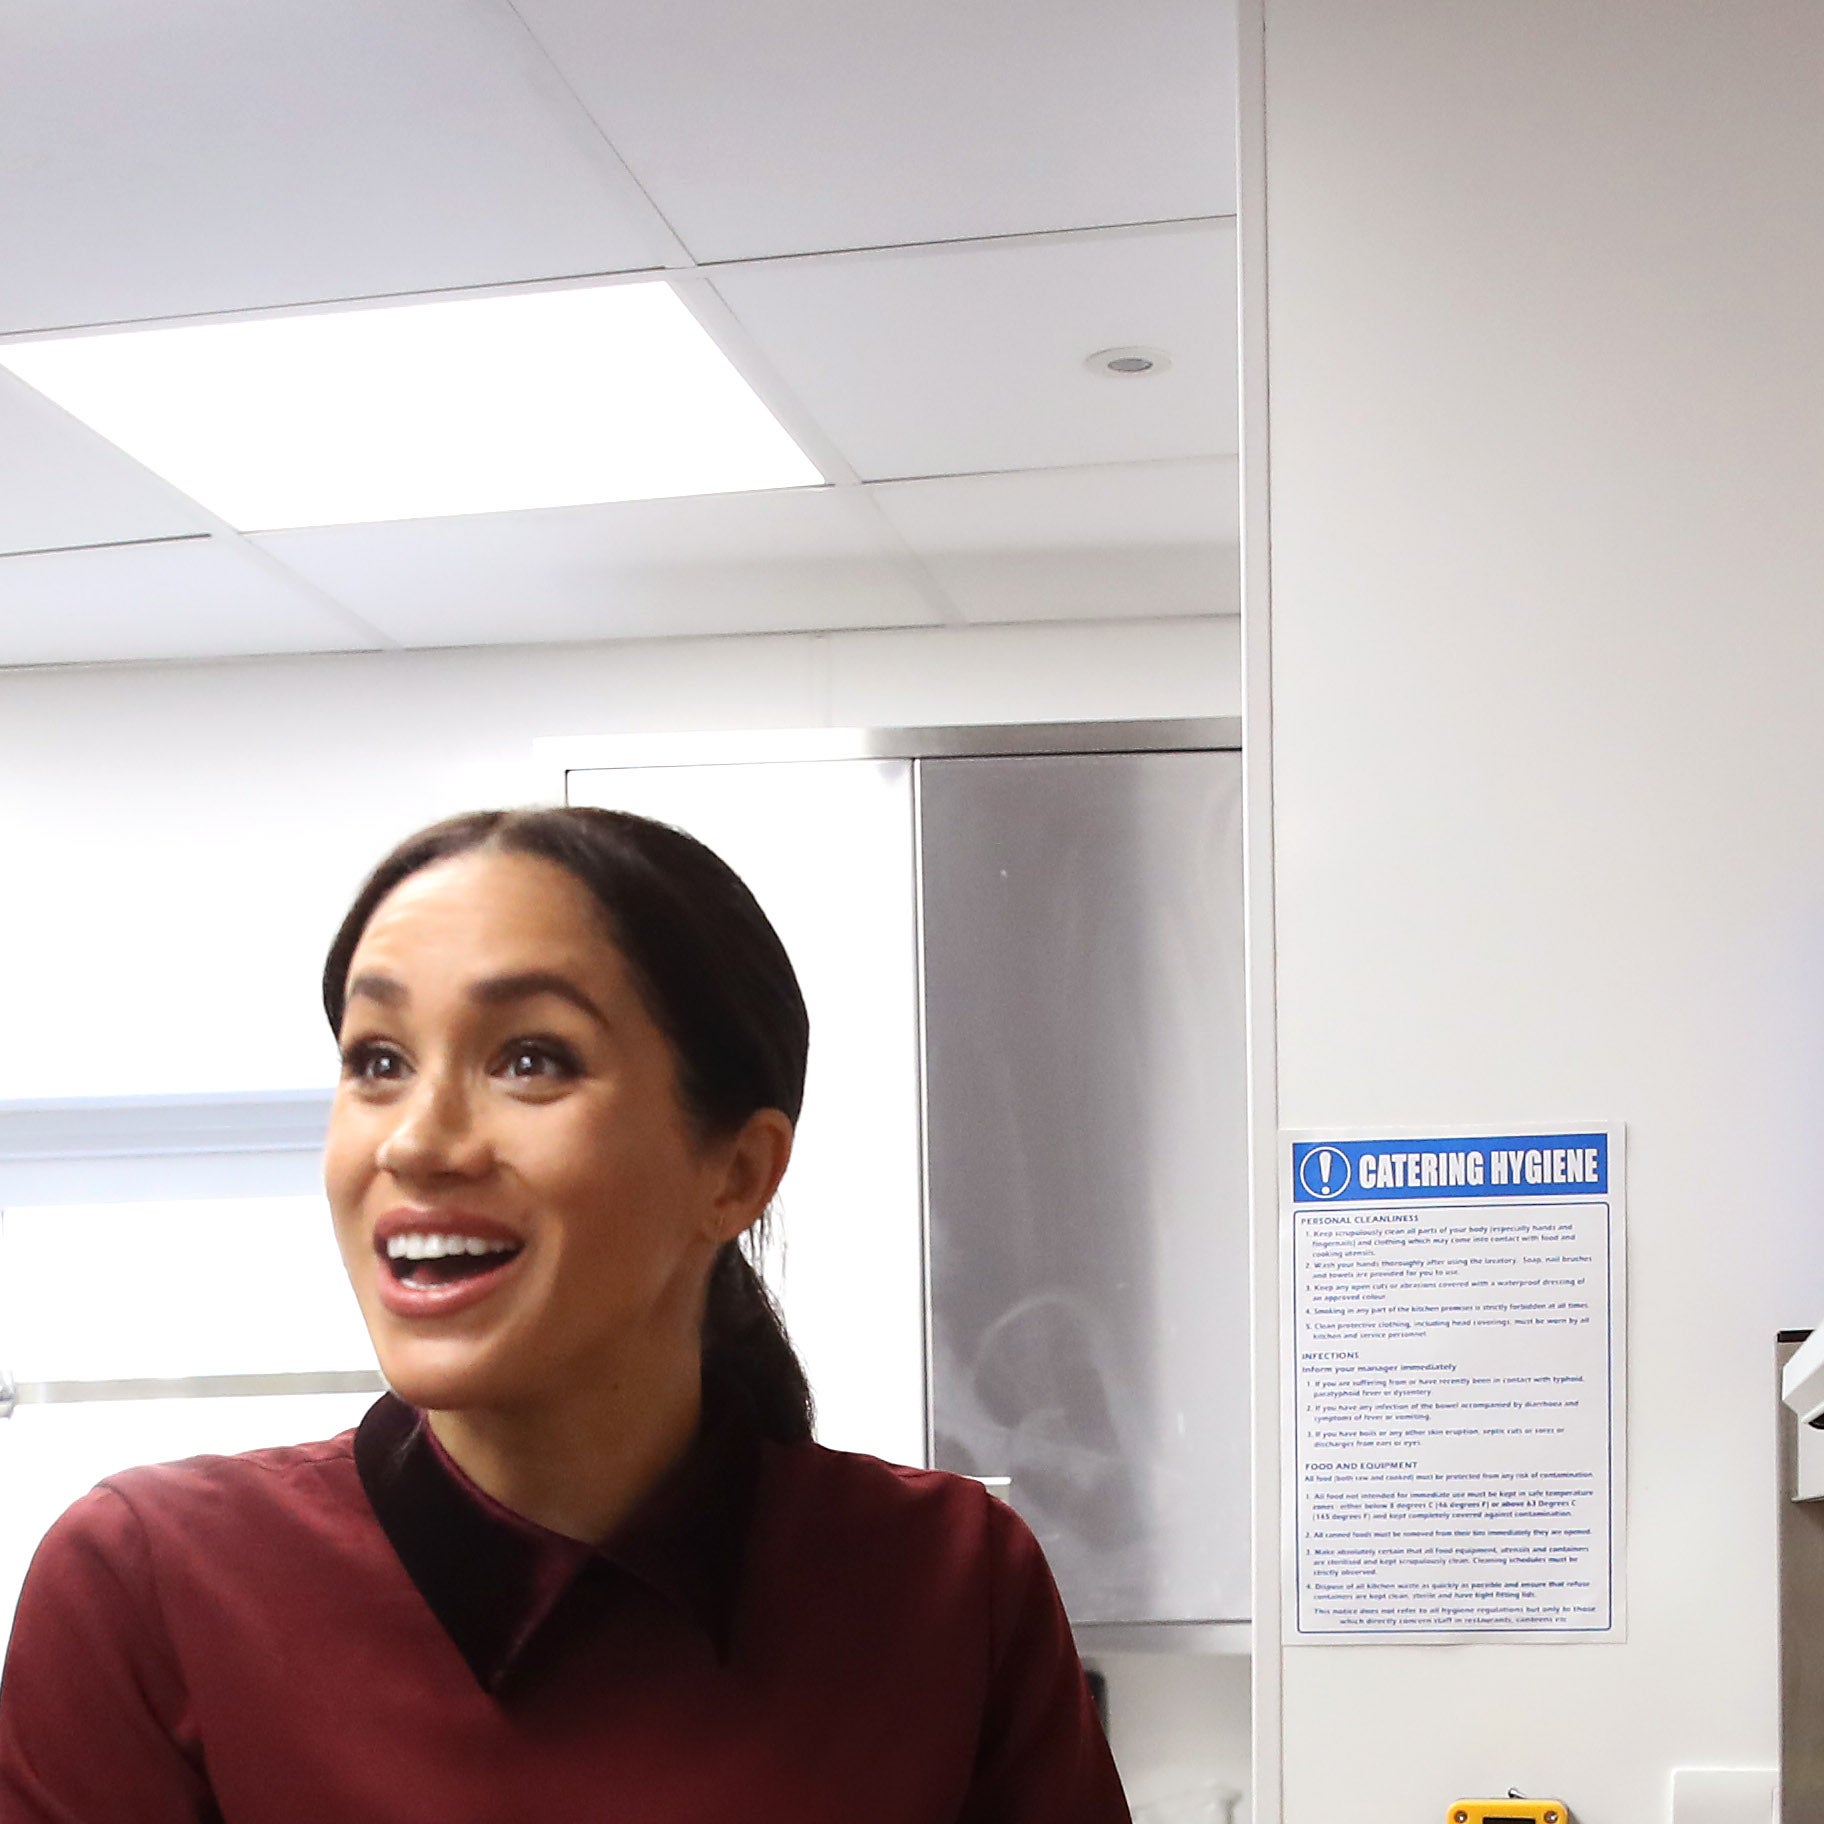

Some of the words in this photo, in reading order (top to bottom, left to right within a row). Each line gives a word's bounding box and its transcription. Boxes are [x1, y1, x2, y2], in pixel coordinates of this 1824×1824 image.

[1358, 1151, 1485, 1189] CATERING
[1490, 1148, 1599, 1186] HYGIENE
[1300, 1216, 1350, 1225] PERSONAL
[1353, 1214, 1418, 1223] CLEANLINESS
[1301, 1351, 1359, 1360] INFECTIONS
[1334, 1366, 1355, 1374] your
[1357, 1365, 1397, 1373] manager
[1400, 1363, 1456, 1372] immediately
[1359, 1461, 1417, 1469] EQUIPMENT
